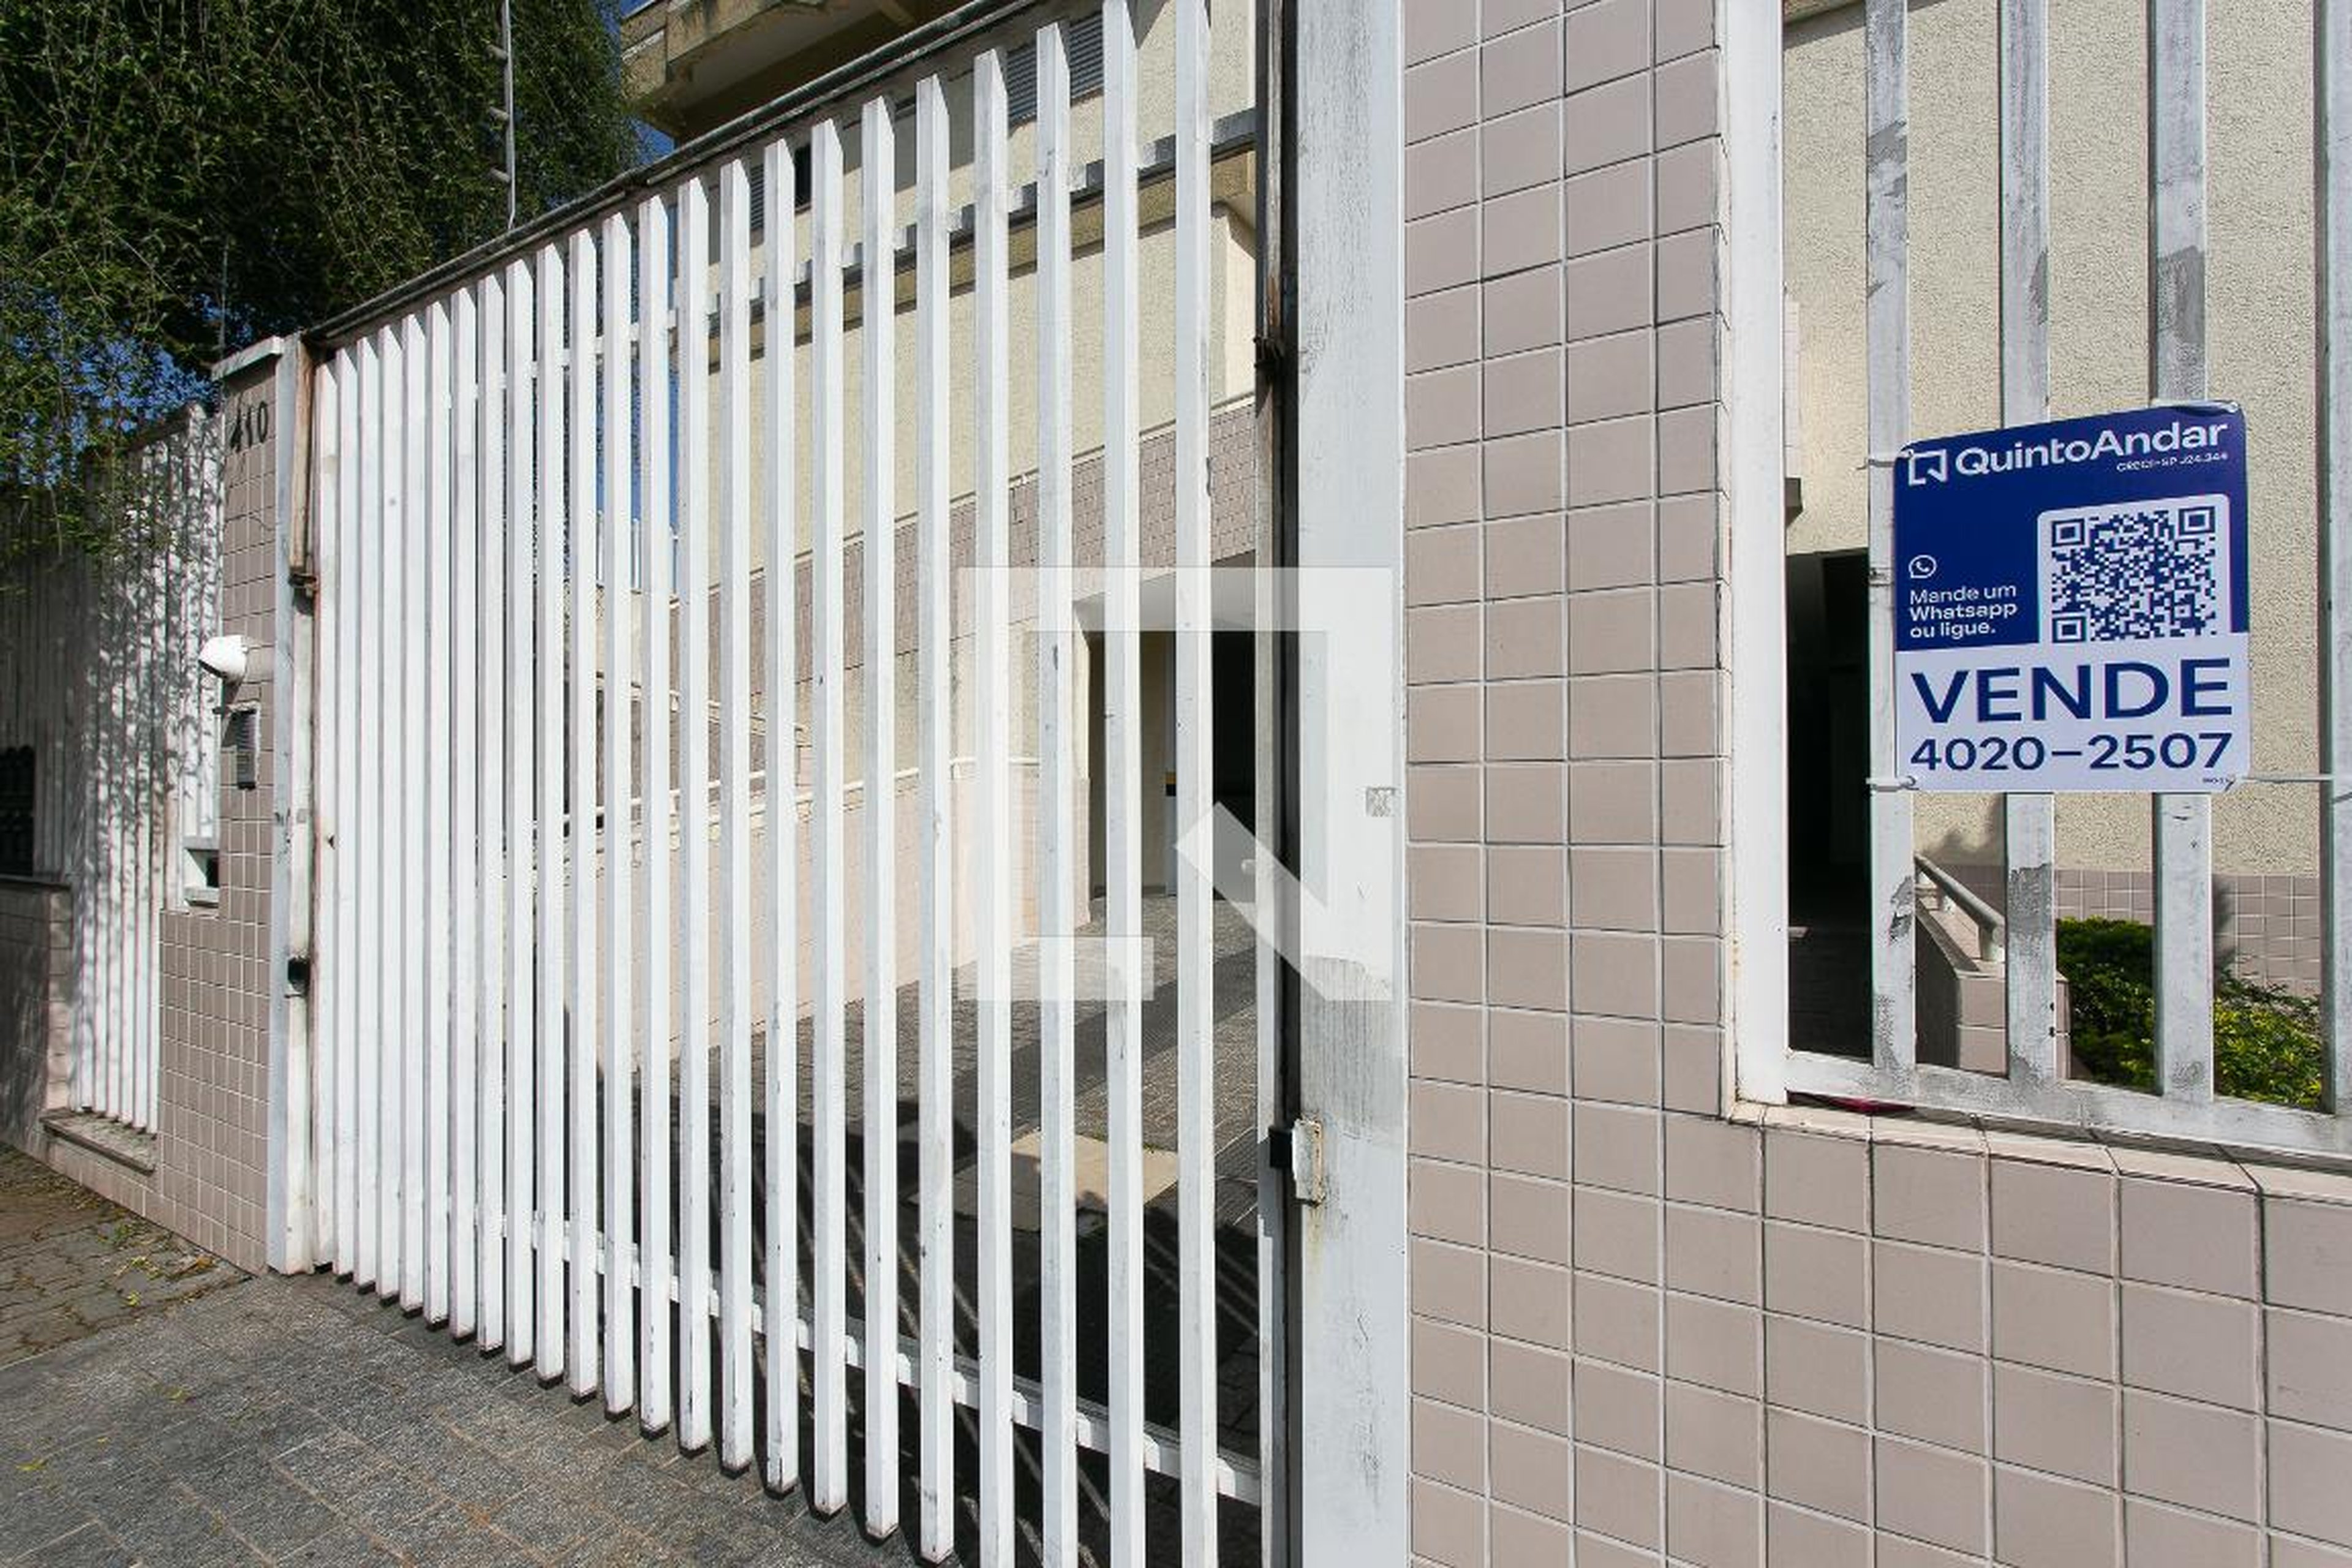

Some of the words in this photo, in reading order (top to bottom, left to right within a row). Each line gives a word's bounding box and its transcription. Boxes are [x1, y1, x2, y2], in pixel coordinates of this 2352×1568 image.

[1956, 423, 2228, 476] QuintoAndar
[1910, 586, 1979, 605] Mande
[1984, 585, 2017, 599] um
[1909, 603, 2018, 622] Whatsapp
[1910, 625, 1935, 638] ou
[1940, 621, 1996, 640] ligue.
[1911, 658, 2233, 723] VENDE
[1910, 733, 2233, 771] 4020-2507
